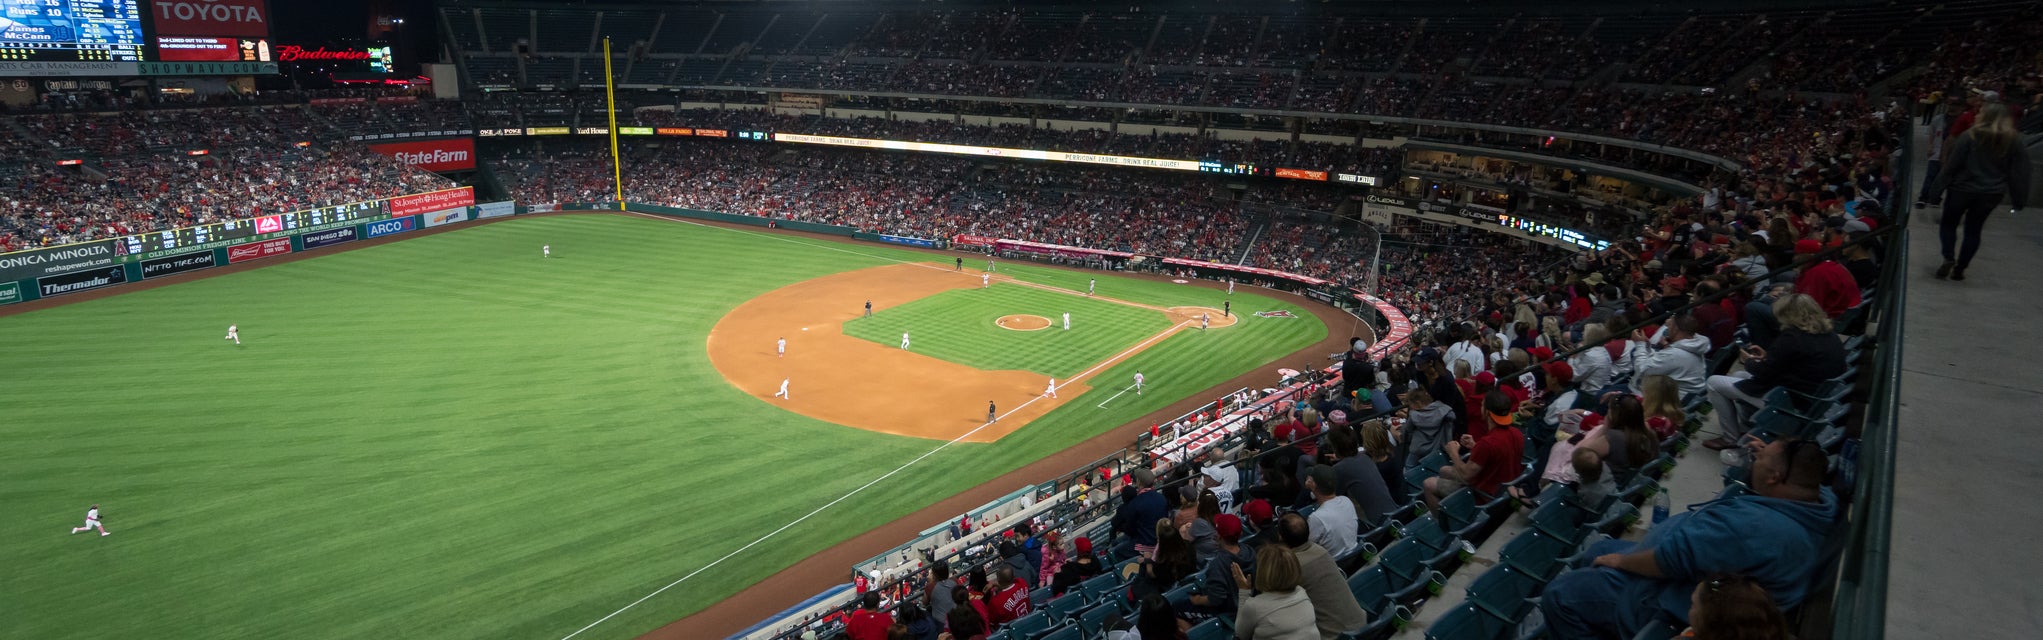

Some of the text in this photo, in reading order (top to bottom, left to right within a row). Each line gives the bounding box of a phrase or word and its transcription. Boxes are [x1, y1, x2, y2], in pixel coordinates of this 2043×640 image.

[10, 7, 38, 15] Runs
[156, 1, 263, 22] TOYOTA
[8, 24, 45, 32] James
[275, 45, 371, 61] Budweiser
[45, 80, 112, 91] Captain Morgan
[448, 189, 469, 198] Health
[273, 229, 298, 237] HELPING
[370, 221, 402, 235] ARCO
[50, 246, 109, 262] MINOLTA
[165, 244, 201, 255] DOMINION
[45, 258, 111, 273] reshapework.com
[145, 255, 212, 273] NITTO TIRE.COM
[43, 277, 110, 294] Thermador
[1177, 422, 1232, 450] 2017
[1220, 501, 1229, 513] 7
